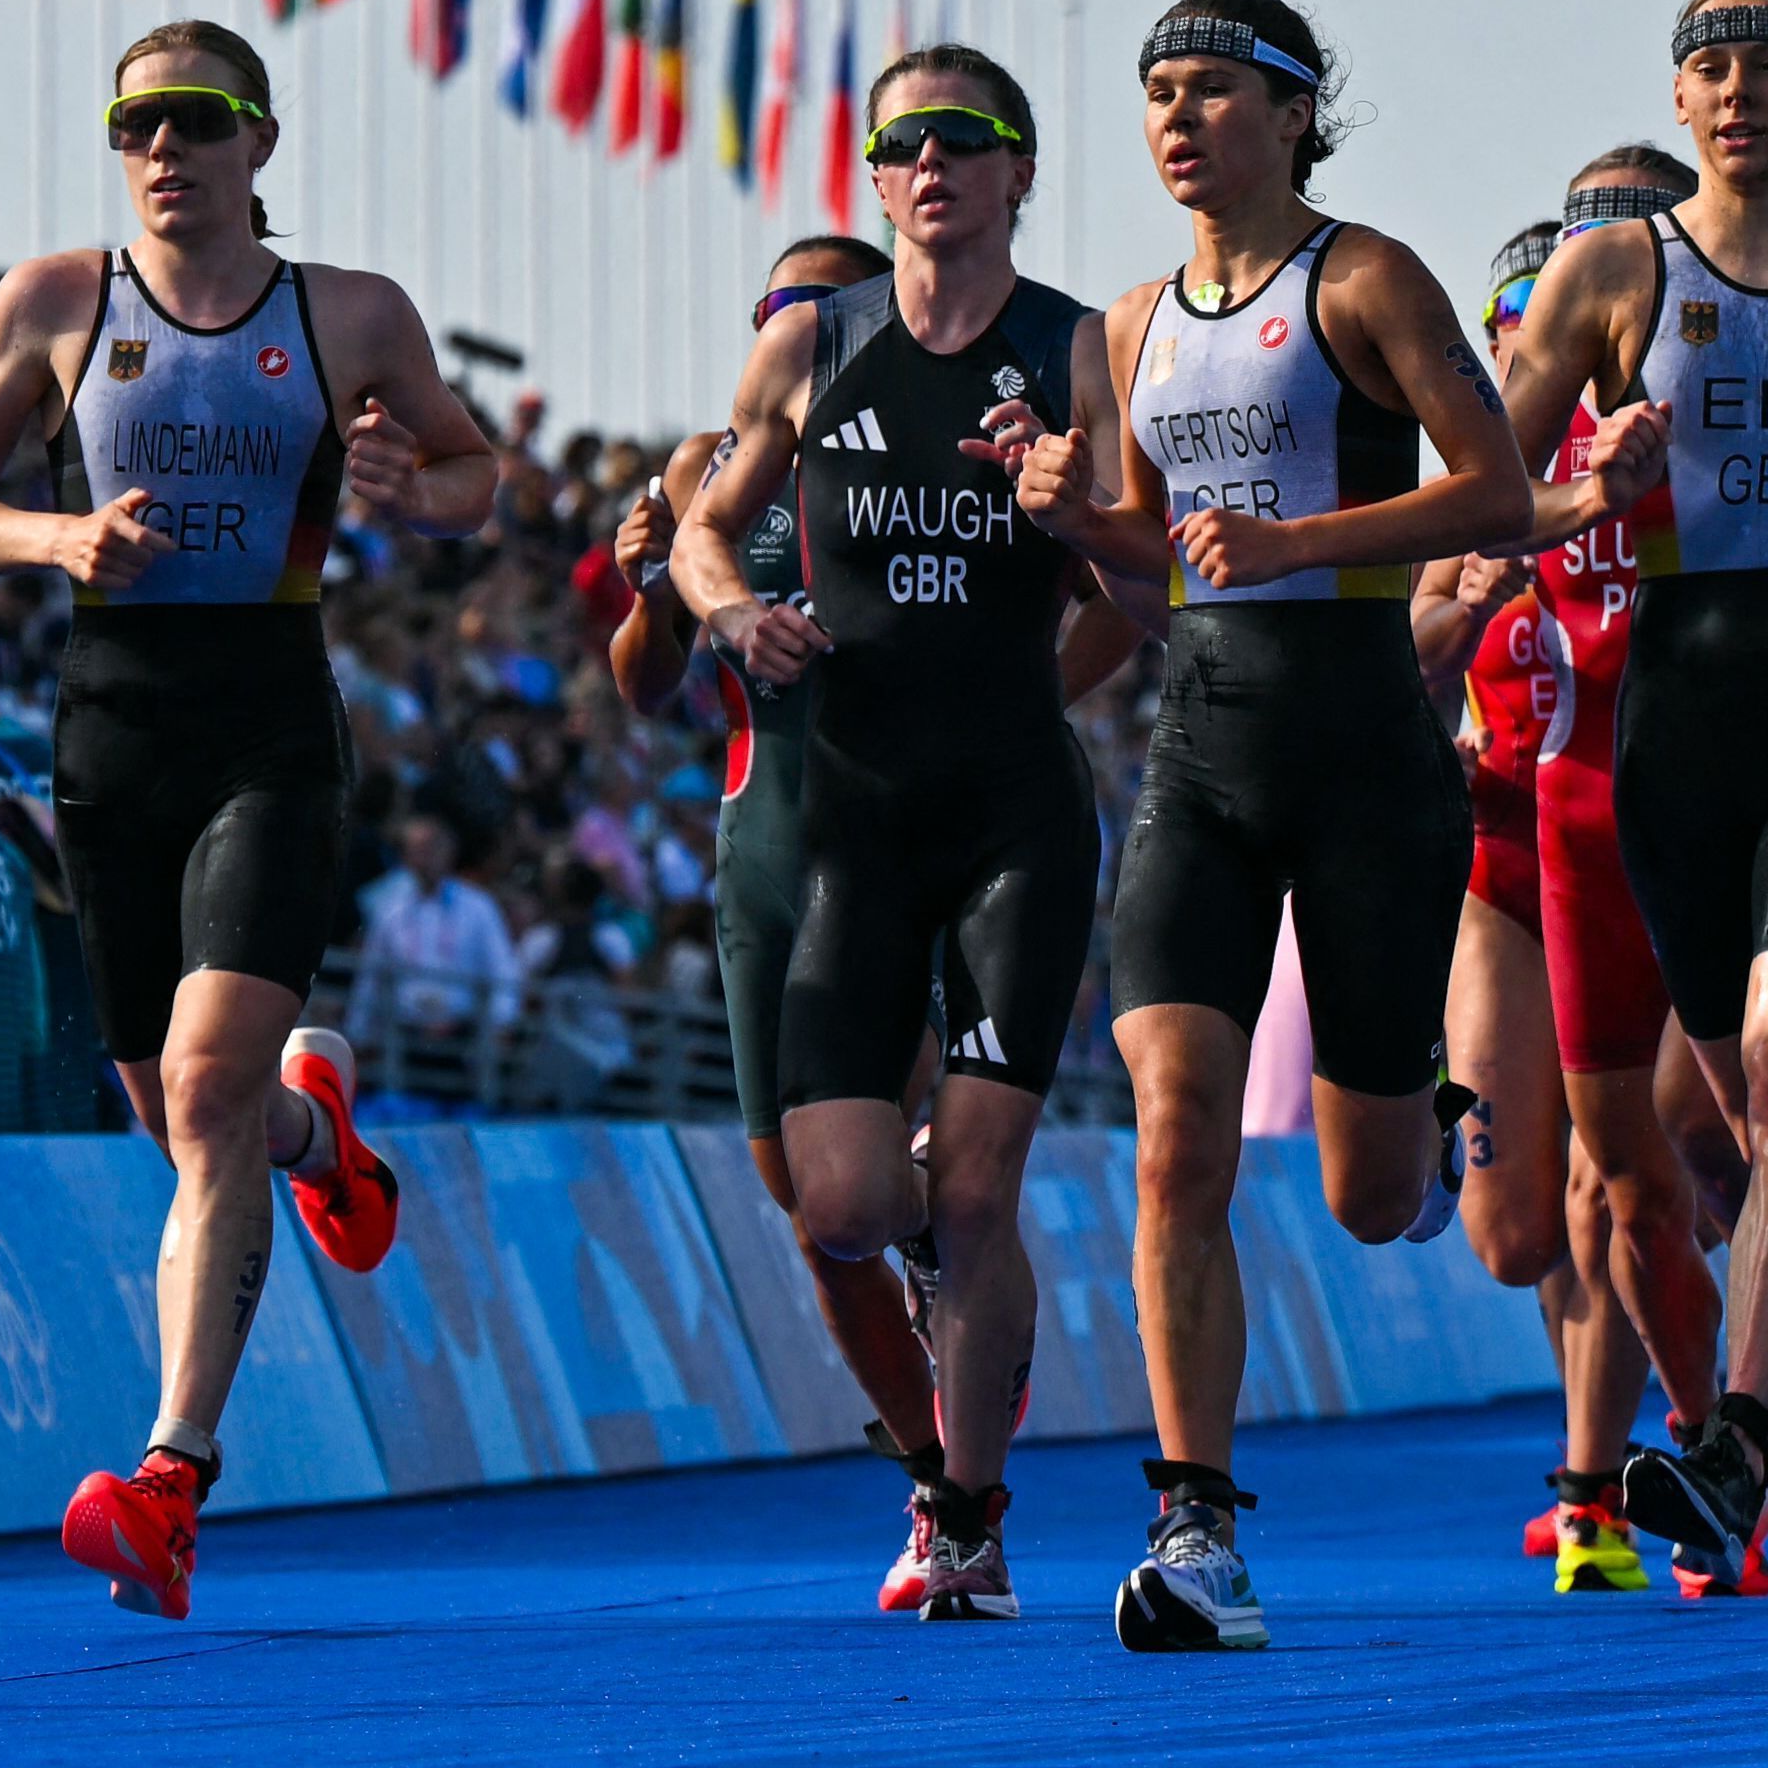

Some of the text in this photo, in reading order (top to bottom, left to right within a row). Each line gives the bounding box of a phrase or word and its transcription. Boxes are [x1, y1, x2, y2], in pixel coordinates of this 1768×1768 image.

[1443, 341, 1506, 414] 38
[112, 418, 283, 477] LINDEMANN
[1149, 399, 1300, 467] TERTSCH
[140, 502, 248, 552] GER
[846, 485, 1015, 545] WAUGH
[887, 553, 969, 605] GBR
[233, 1250, 263, 1335] 37
